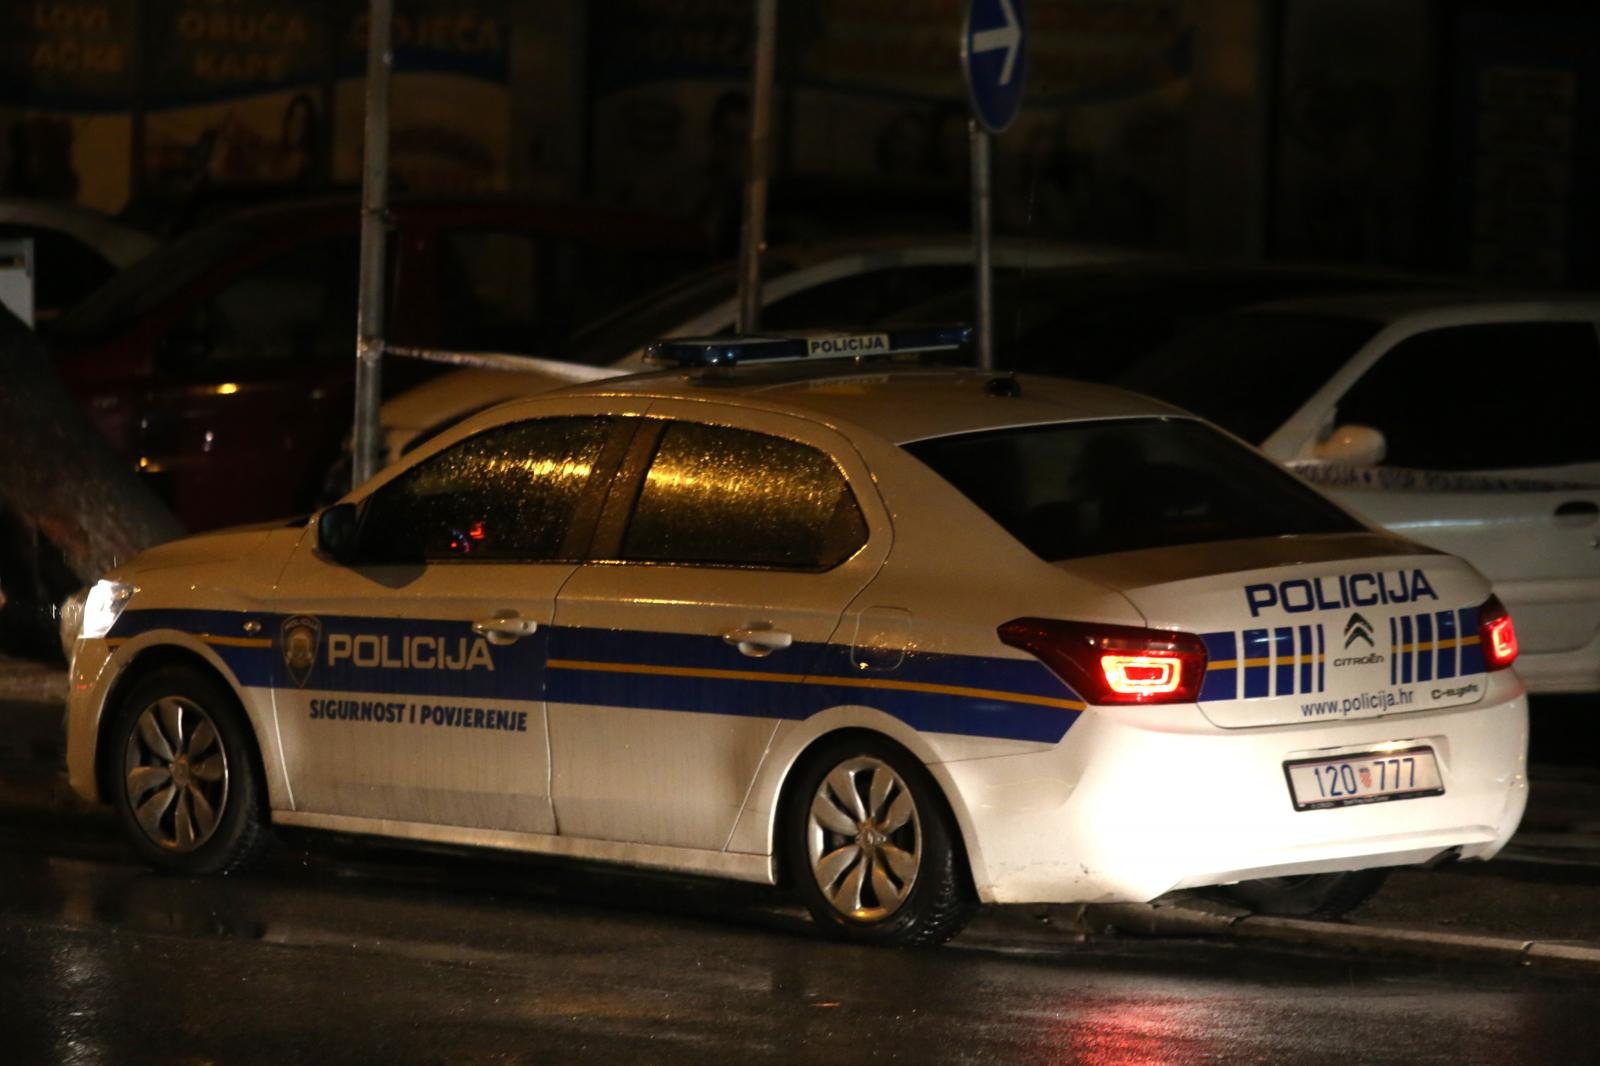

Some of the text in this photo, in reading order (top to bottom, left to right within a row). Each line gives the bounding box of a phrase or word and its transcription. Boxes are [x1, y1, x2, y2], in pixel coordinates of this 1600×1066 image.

[811, 337, 885, 353] POLICIJA
[1244, 569, 1439, 617] POLICIJA
[328, 634, 496, 671] POLICIJA
[310, 699, 528, 732] SIGURNOST I POVJERENJE
[1301, 689, 1414, 717] www.policija.hr
[1314, 757, 1415, 797] 120 777
